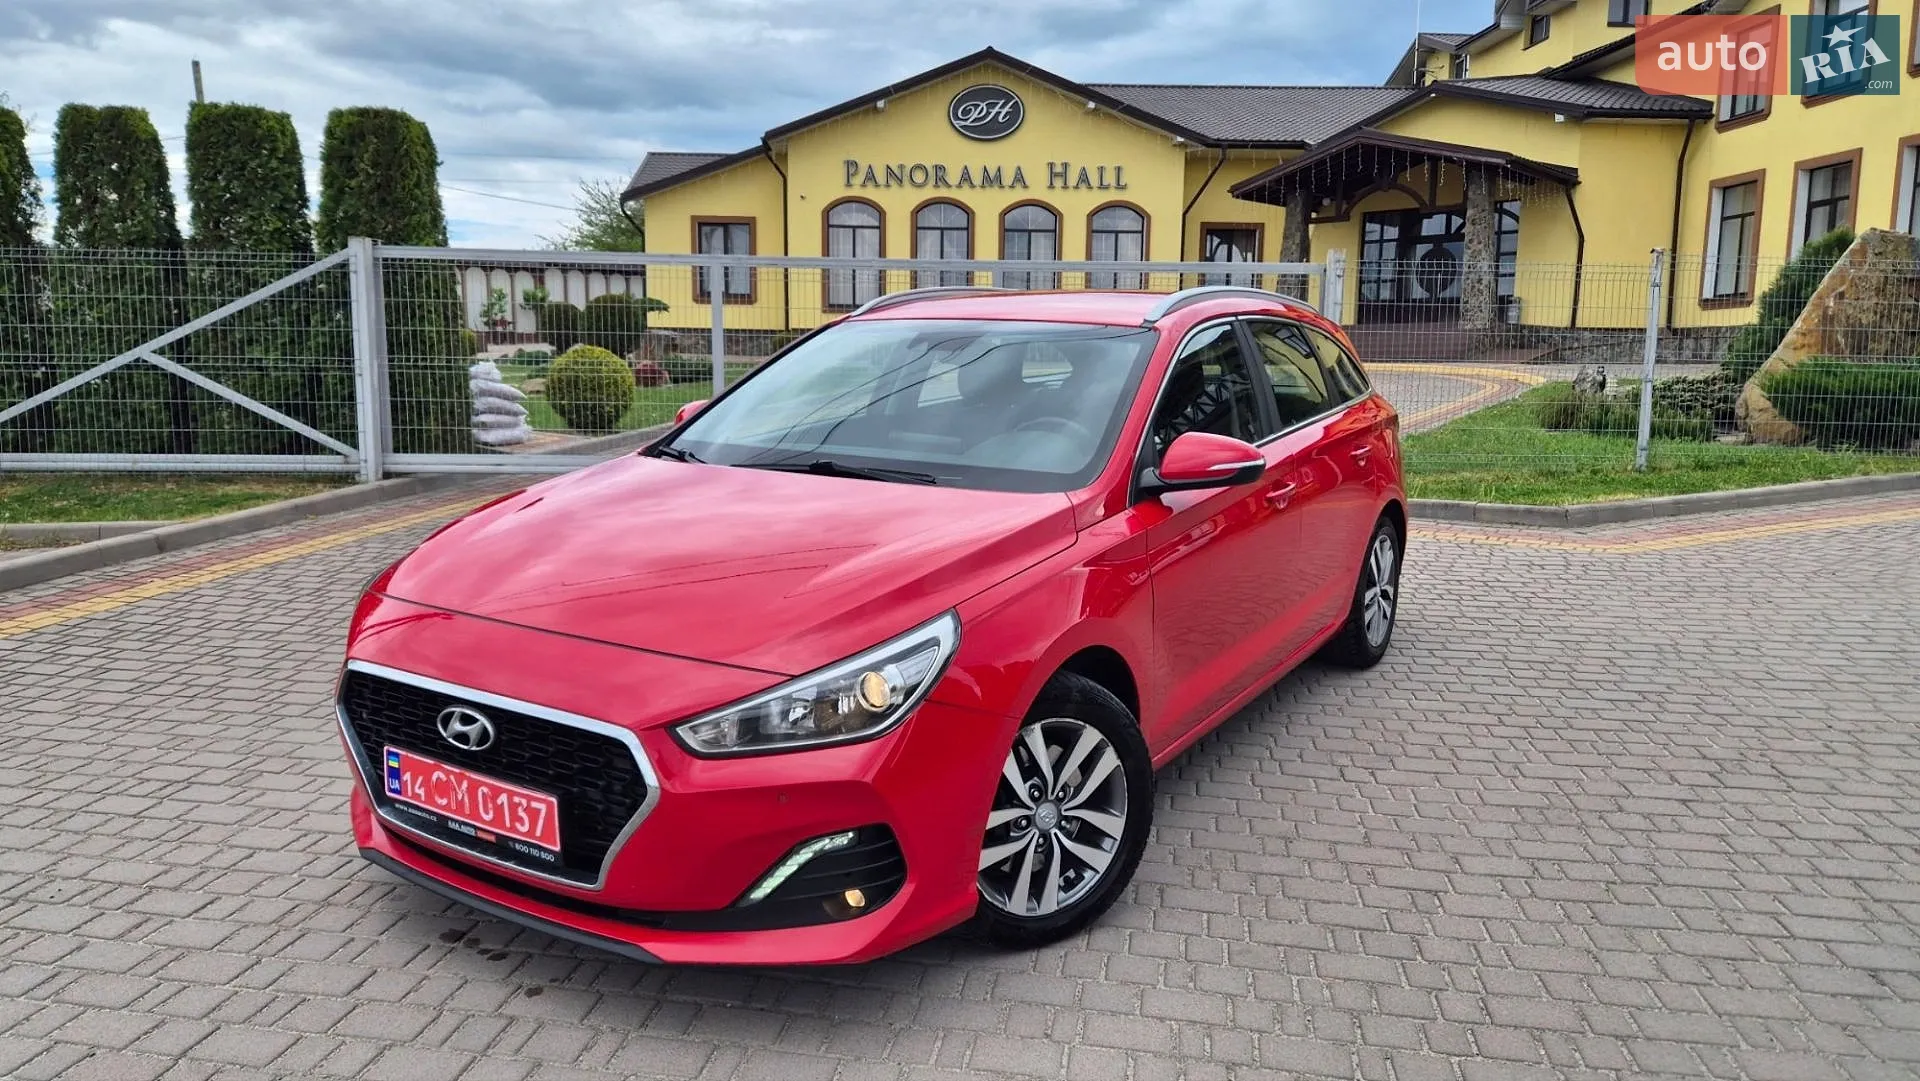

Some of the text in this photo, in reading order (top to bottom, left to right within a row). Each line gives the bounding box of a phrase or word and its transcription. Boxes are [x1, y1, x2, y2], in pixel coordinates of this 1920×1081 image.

[843, 159, 1128, 190] PANORAMA HALL
[389, 778, 400, 791] UA
[403, 771, 425, 801] 14
[477, 786, 547, 837] 0137
